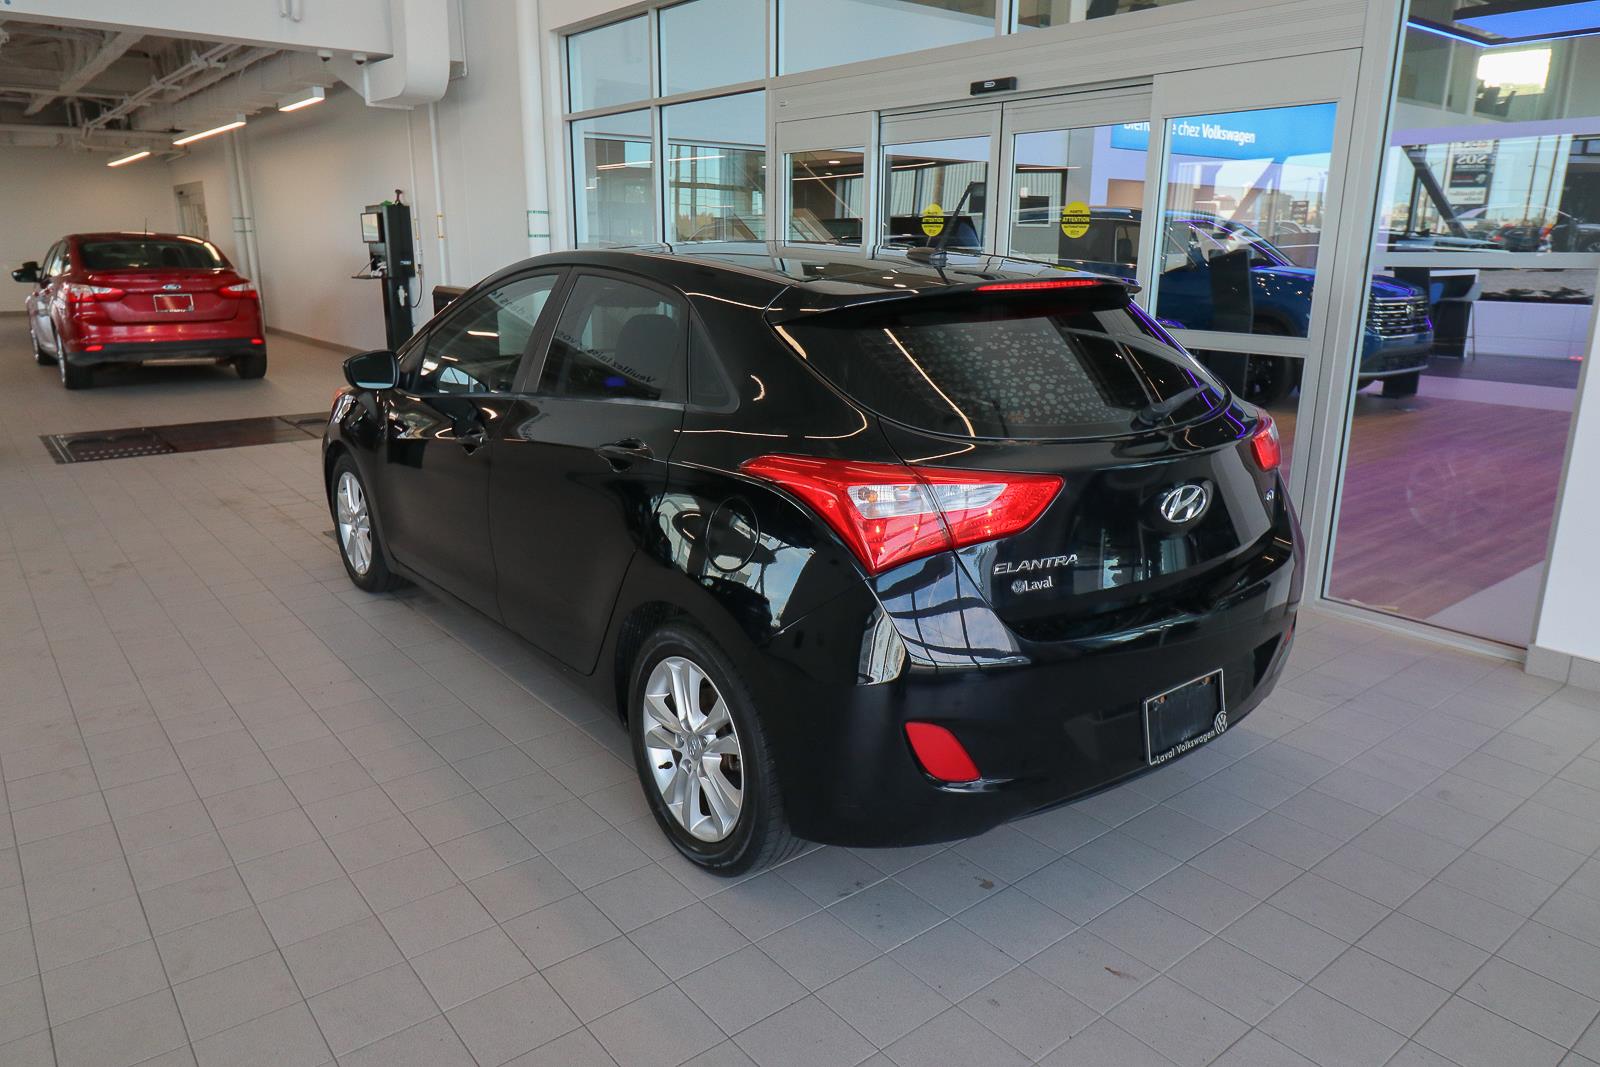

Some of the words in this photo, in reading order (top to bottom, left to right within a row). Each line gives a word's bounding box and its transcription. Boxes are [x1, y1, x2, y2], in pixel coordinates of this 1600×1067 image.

[1177, 121, 1199, 137] chez
[1201, 123, 1256, 146] Volkswagen
[993, 553, 1079, 575] ELANTRA
[1025, 575, 1053, 592] Laval
[1155, 747, 1175, 764] Laval
[1176, 729, 1216, 754] Volkswagen
